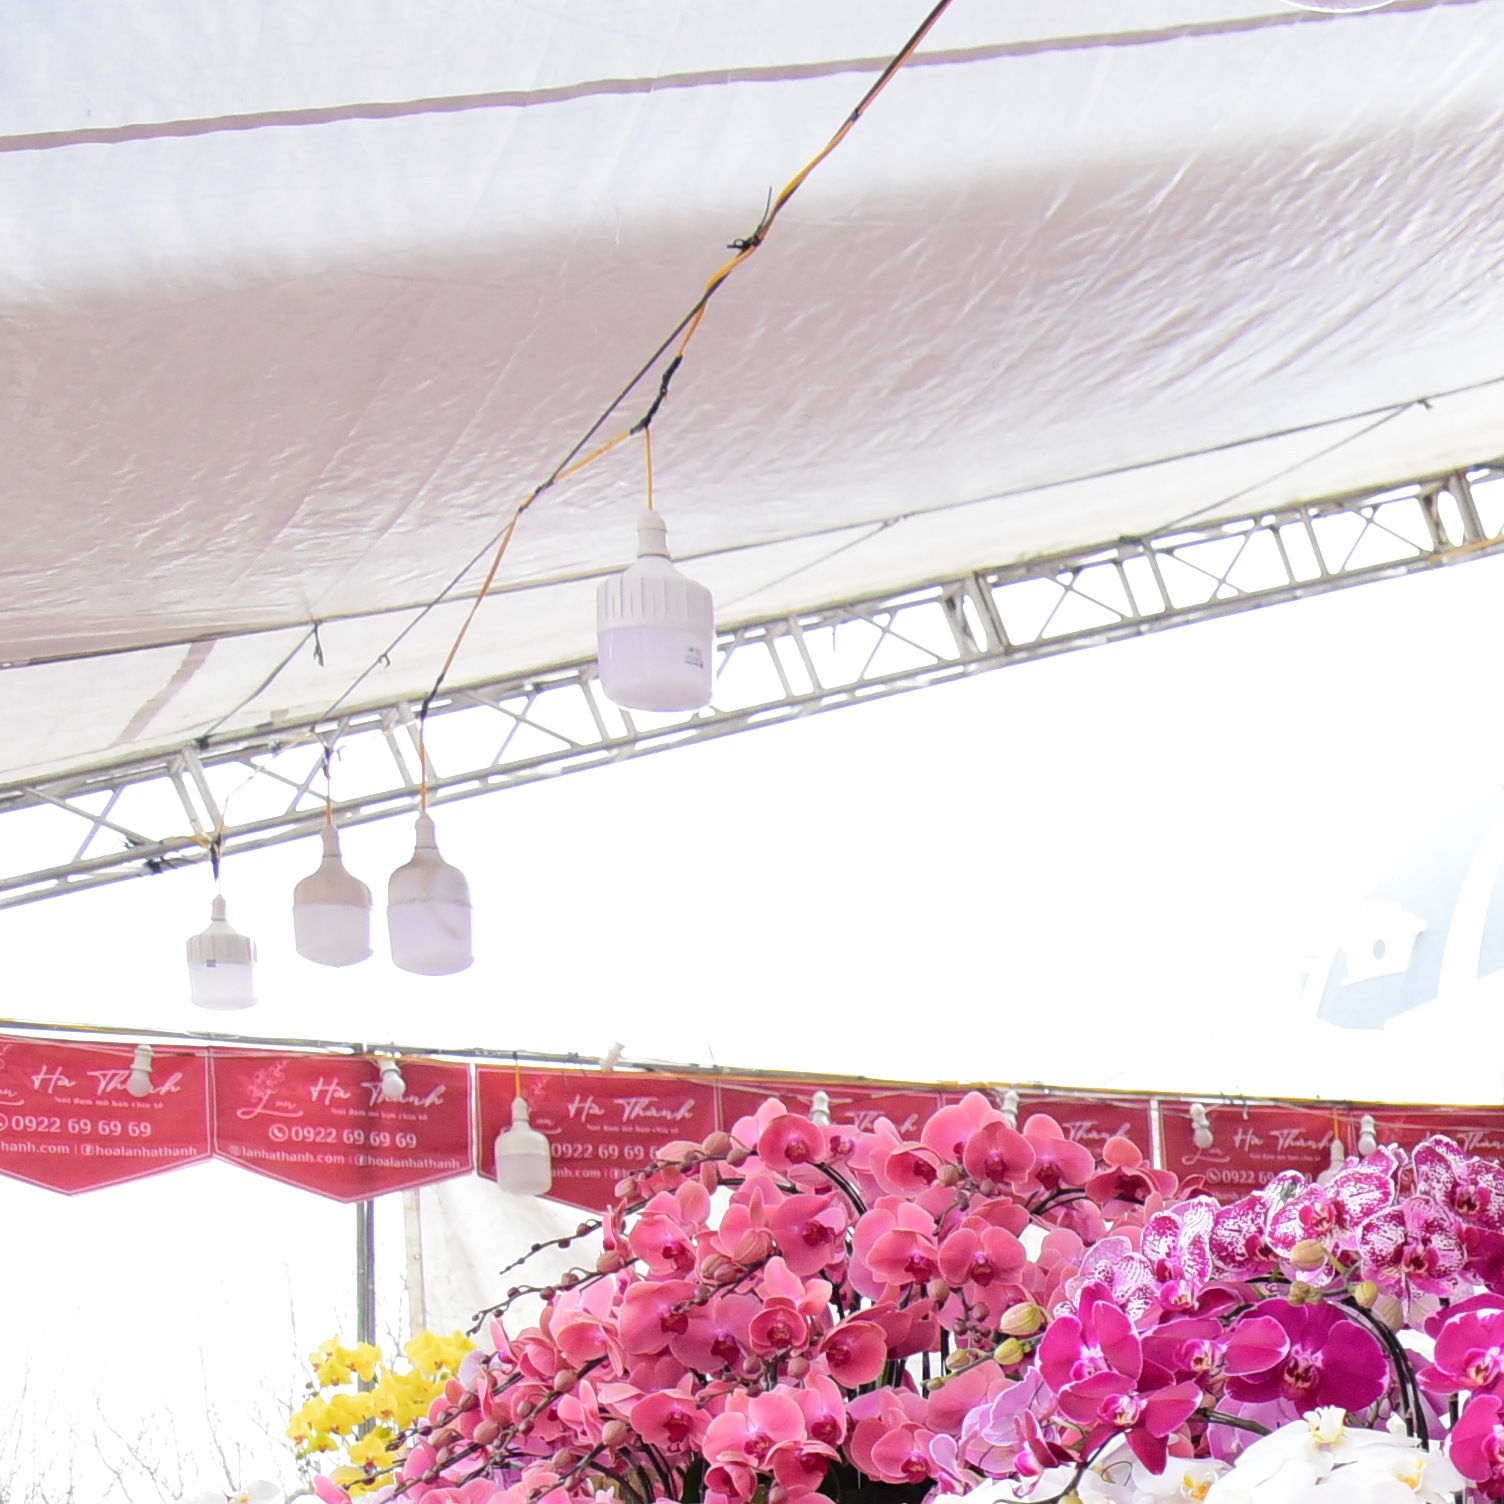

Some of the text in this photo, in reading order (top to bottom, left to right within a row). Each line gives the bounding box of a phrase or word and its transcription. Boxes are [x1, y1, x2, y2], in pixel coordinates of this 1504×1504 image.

[12, 1115, 152, 1138] 0922 69 69 69
[291, 1126, 417, 1149] 0922 69 69 69
[552, 1143, 593, 1159] 0922
[598, 1143, 619, 1159] 69
[624, 1144, 644, 1160] 69
[1222, 1169, 1255, 1184] 0922
